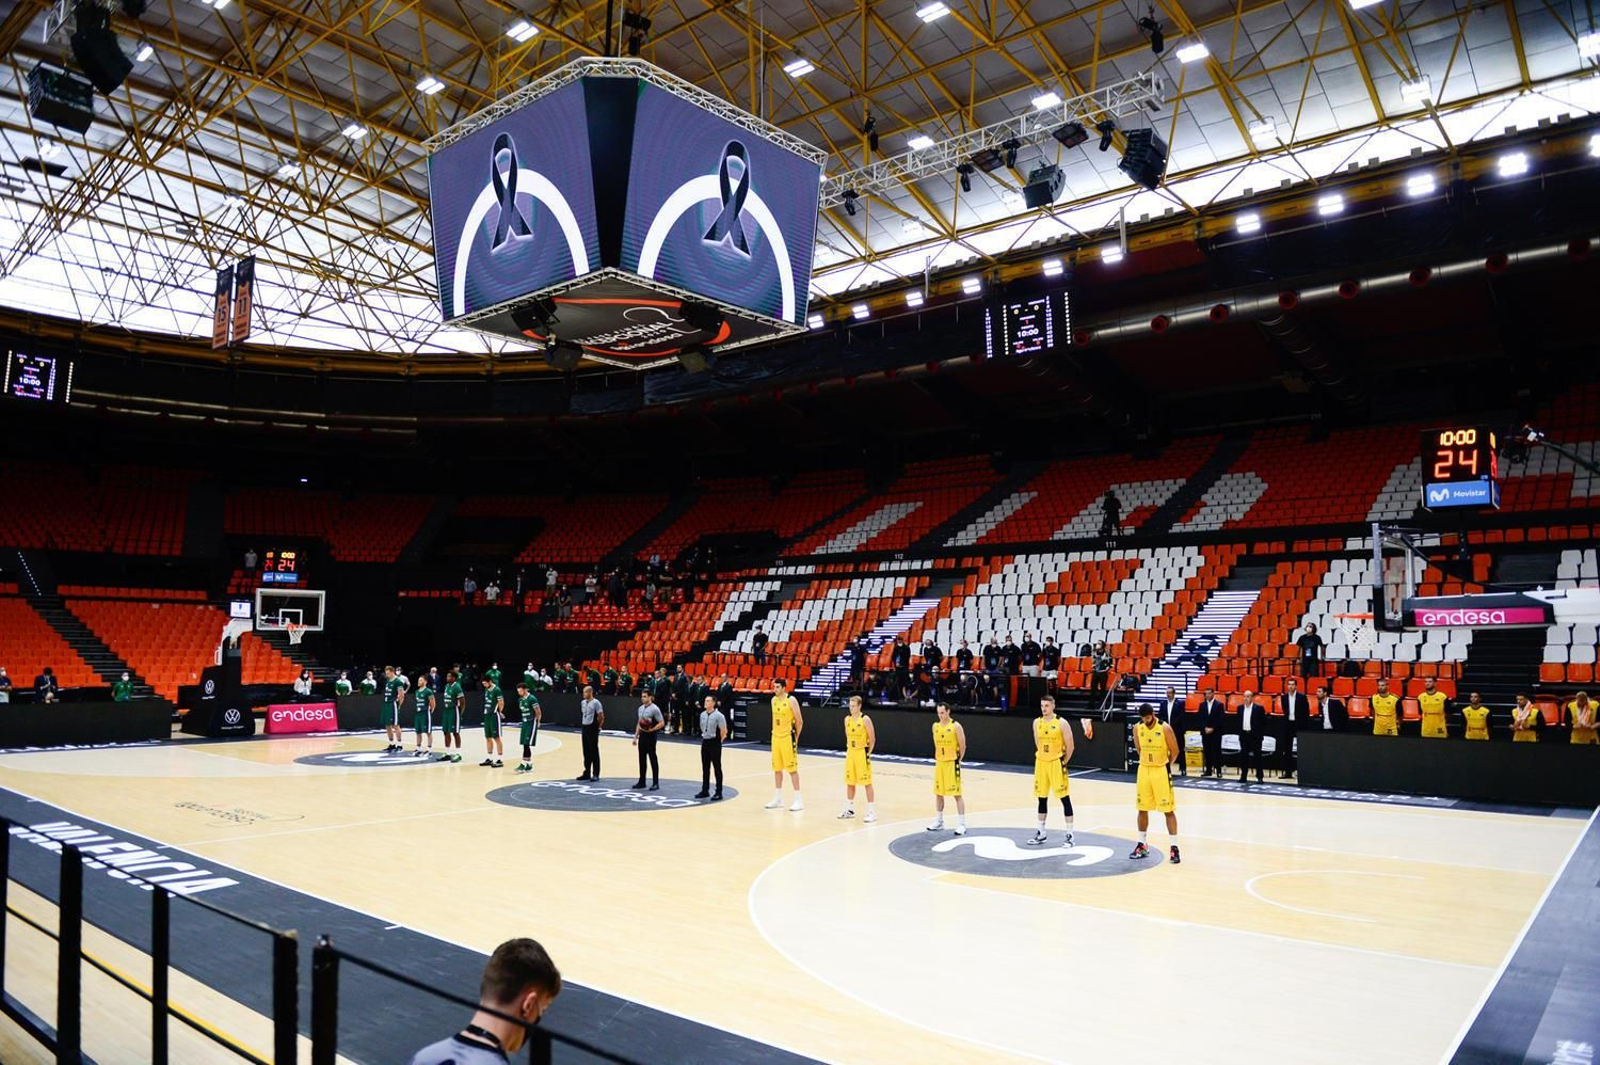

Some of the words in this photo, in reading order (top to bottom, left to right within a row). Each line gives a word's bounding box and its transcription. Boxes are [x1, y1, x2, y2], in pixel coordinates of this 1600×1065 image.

[1017, 328, 1039, 338] 10:00
[19, 376, 41, 386] 10:00
[1440, 429, 1476, 446] 10:00
[1434, 449, 1477, 478] 24
[1453, 489, 1487, 498] Movistar
[277, 559, 296, 572] 24
[1422, 609, 1505, 626] endesa
[272, 707, 334, 722] endesa
[531, 780, 702, 808] endesa
[8, 821, 240, 898] VALENCIA
